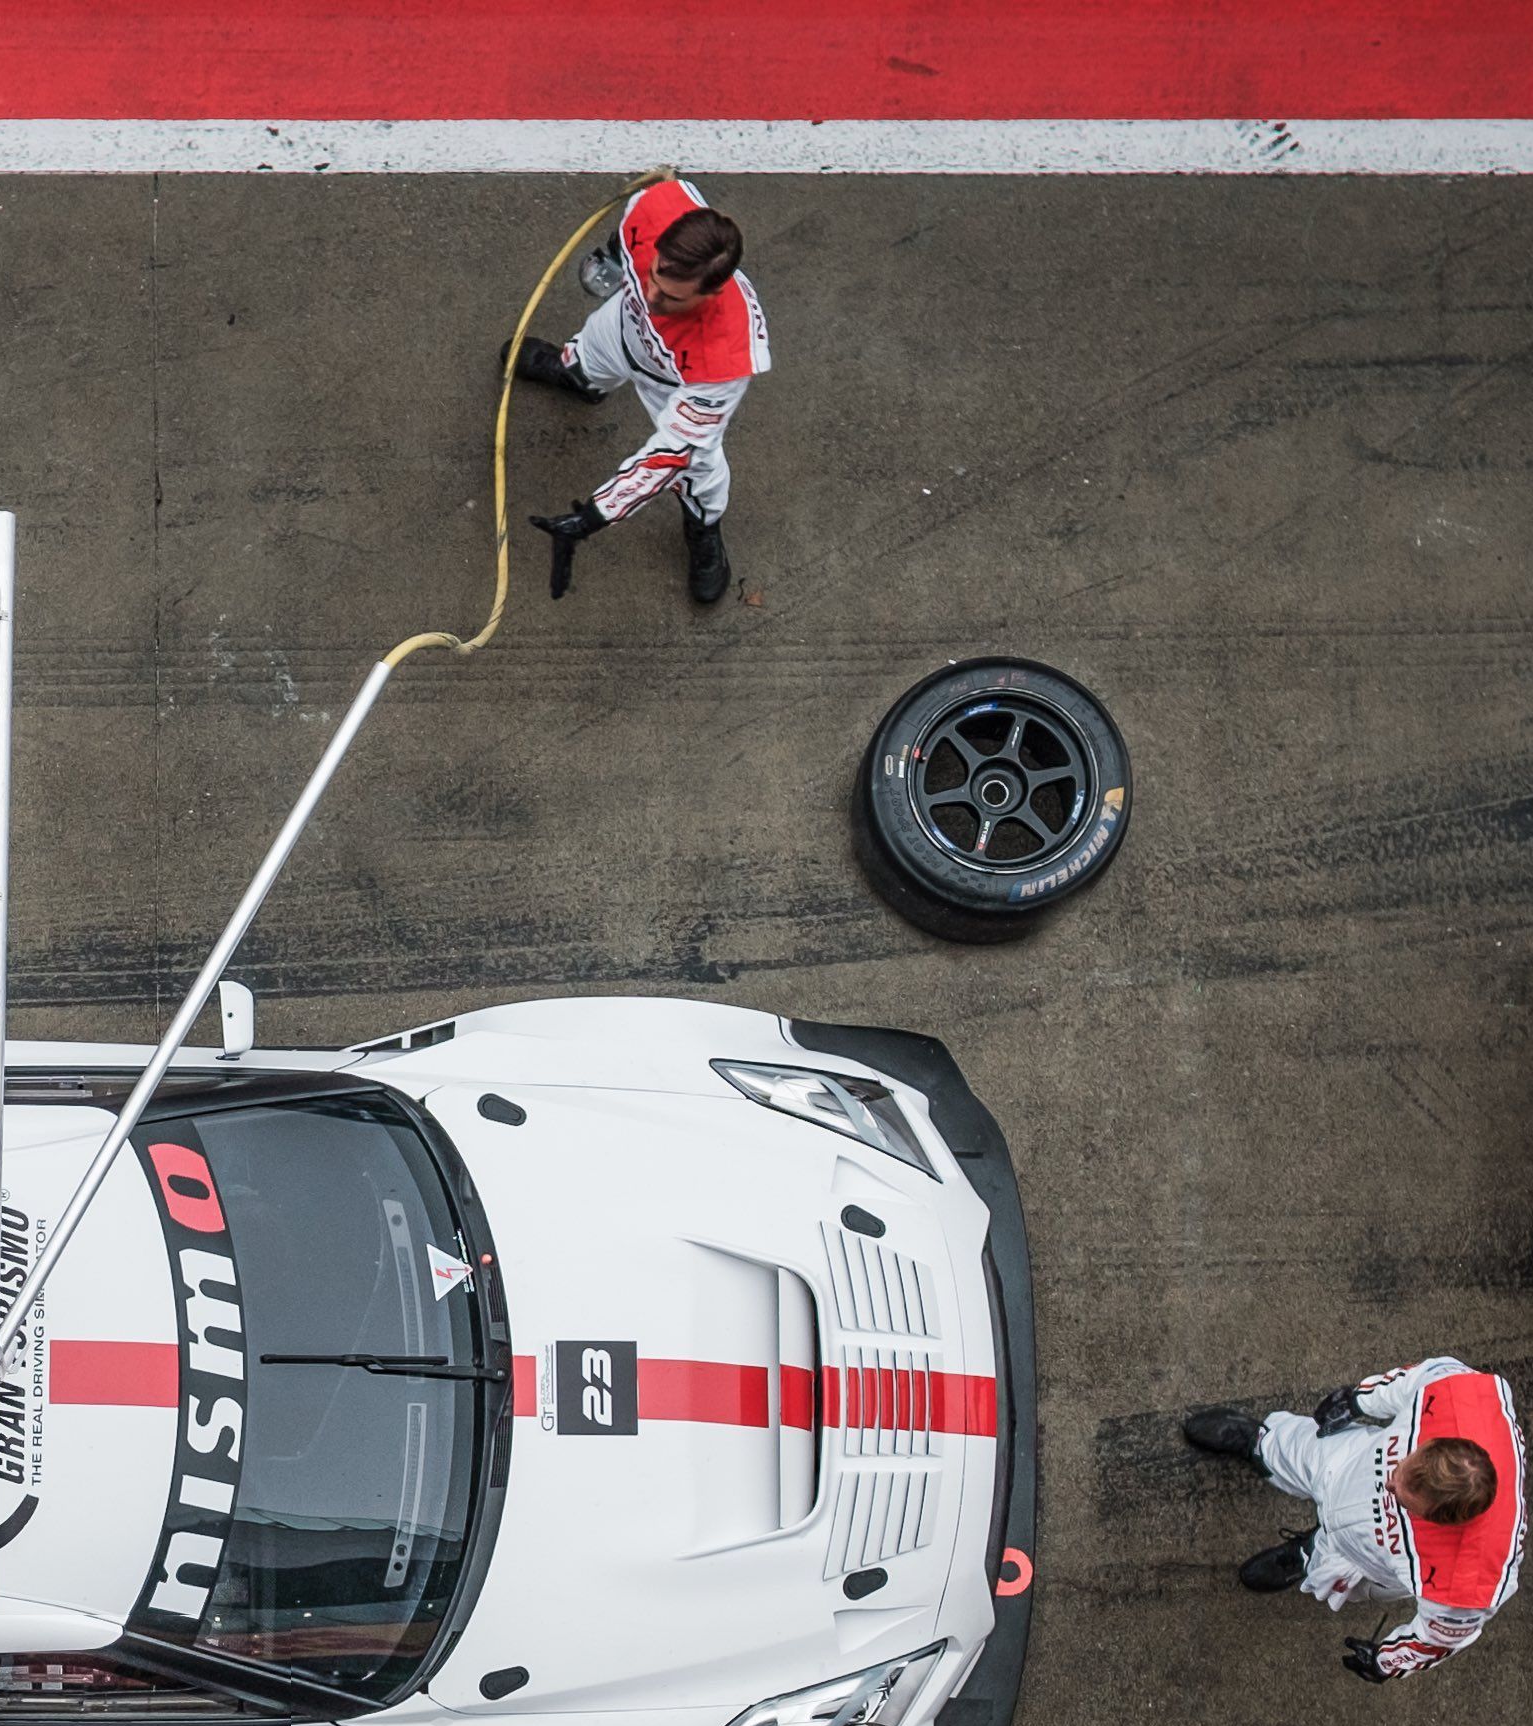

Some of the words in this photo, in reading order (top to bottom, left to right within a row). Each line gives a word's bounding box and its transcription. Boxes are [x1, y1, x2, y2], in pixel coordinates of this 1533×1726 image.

[1019, 824, 1110, 898] MICHELIN
[33, 1325, 44, 1397] DRIVING
[146, 1143, 245, 1620] nismo
[581, 1347, 613, 1427] 23
[32, 1403, 43, 1449] REAL
[541, 1406, 554, 1431] GT
[31, 1453, 42, 1486] THE
